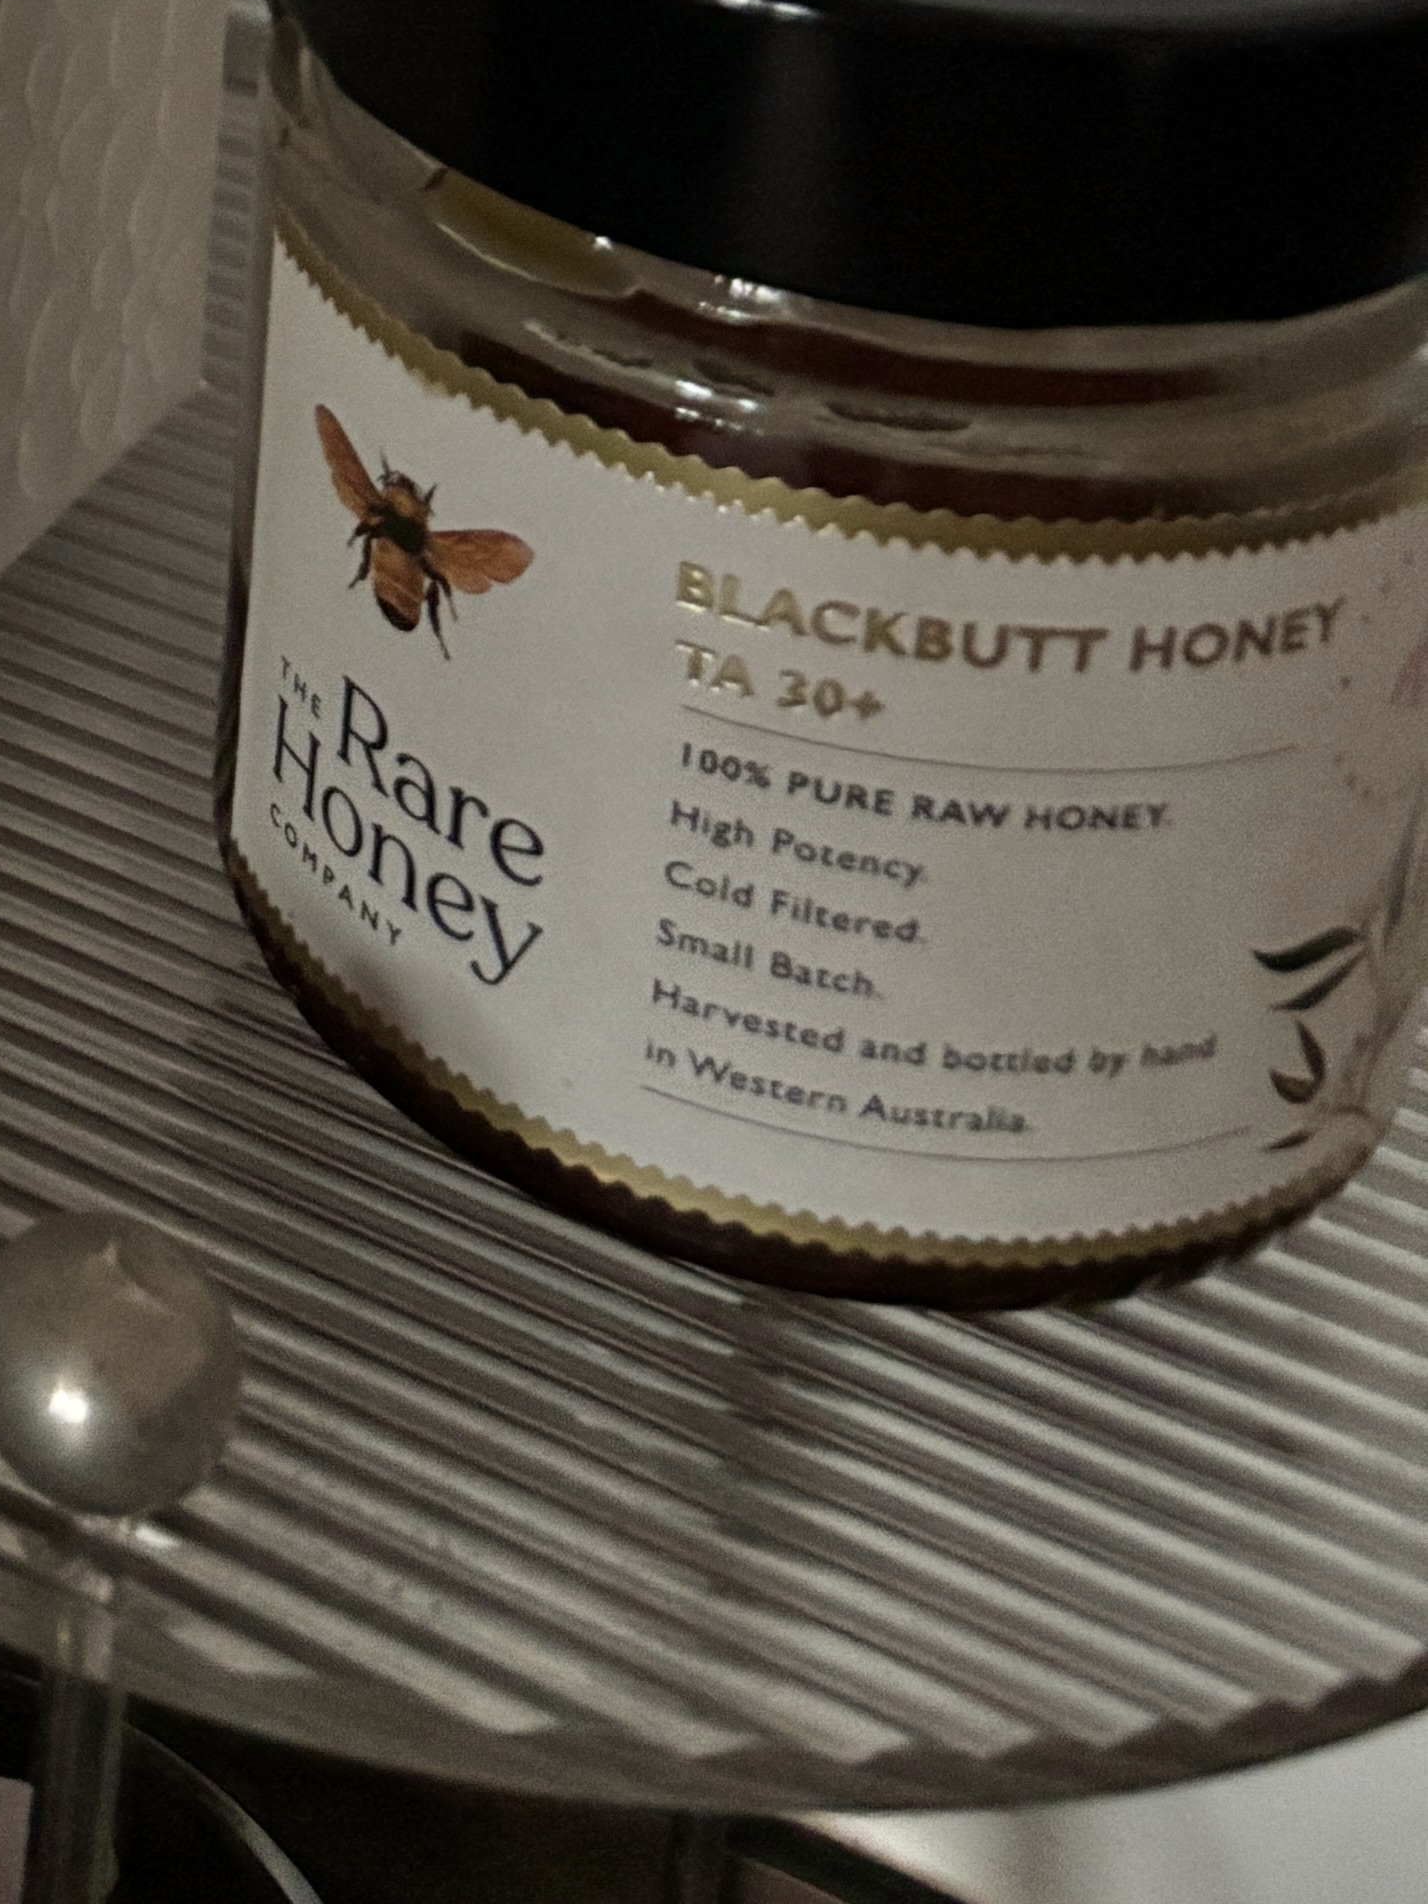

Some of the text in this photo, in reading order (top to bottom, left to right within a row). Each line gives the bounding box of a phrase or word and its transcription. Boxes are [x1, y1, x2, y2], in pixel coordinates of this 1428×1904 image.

[674, 558, 1347, 673] BLACKBUTT HONEY
[673, 638, 887, 721] TA 30+
[281, 655, 545, 887] THE Rare
[678, 741, 771, 792] 100%
[786, 770, 896, 818] PURE
[910, 793, 1012, 830] RAW
[273, 694, 544, 986] Honey
[669, 799, 754, 850] High
[270, 802, 402, 945] COMPANY
[664, 860, 753, 909] Cold
[656, 918, 754, 971] Small
[651, 979, 1218, 1079] Harvested and bottled by hand
[644, 1038, 676, 1070] in
[687, 1048, 847, 1114] Western
